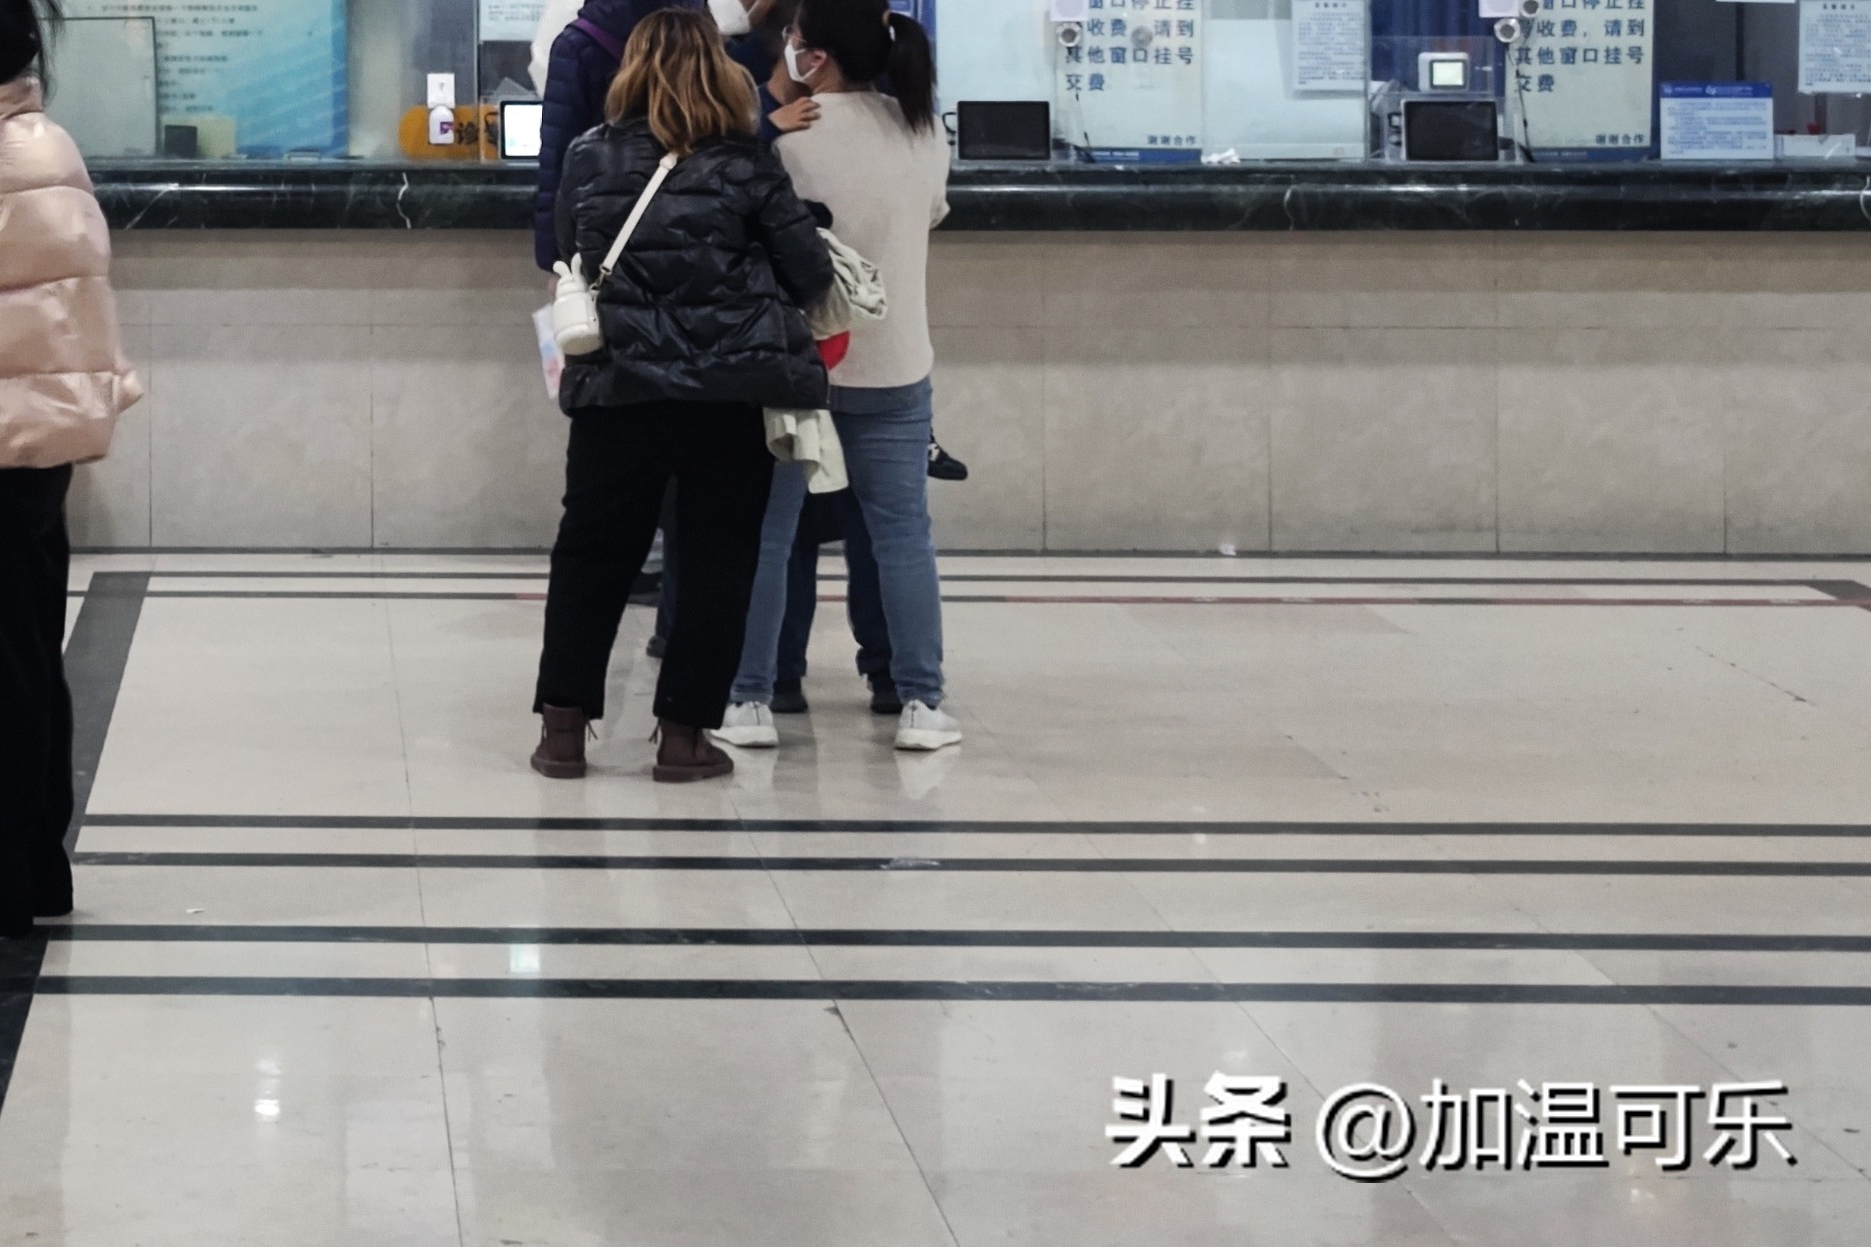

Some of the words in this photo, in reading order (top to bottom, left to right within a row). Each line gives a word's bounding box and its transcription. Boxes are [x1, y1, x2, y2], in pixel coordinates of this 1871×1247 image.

[1087, 18, 1194, 38] 收费请到
[1065, 46, 1193, 65] 其他窗口挂号
[1515, 46, 1644, 65] 其他窗口挂号
[1066, 72, 1105, 91] 交费
[1515, 73, 1555, 92] 交费
[1148, 135, 1196, 145] 谢谢合作
[1595, 134, 1645, 145] 谢谢合作
